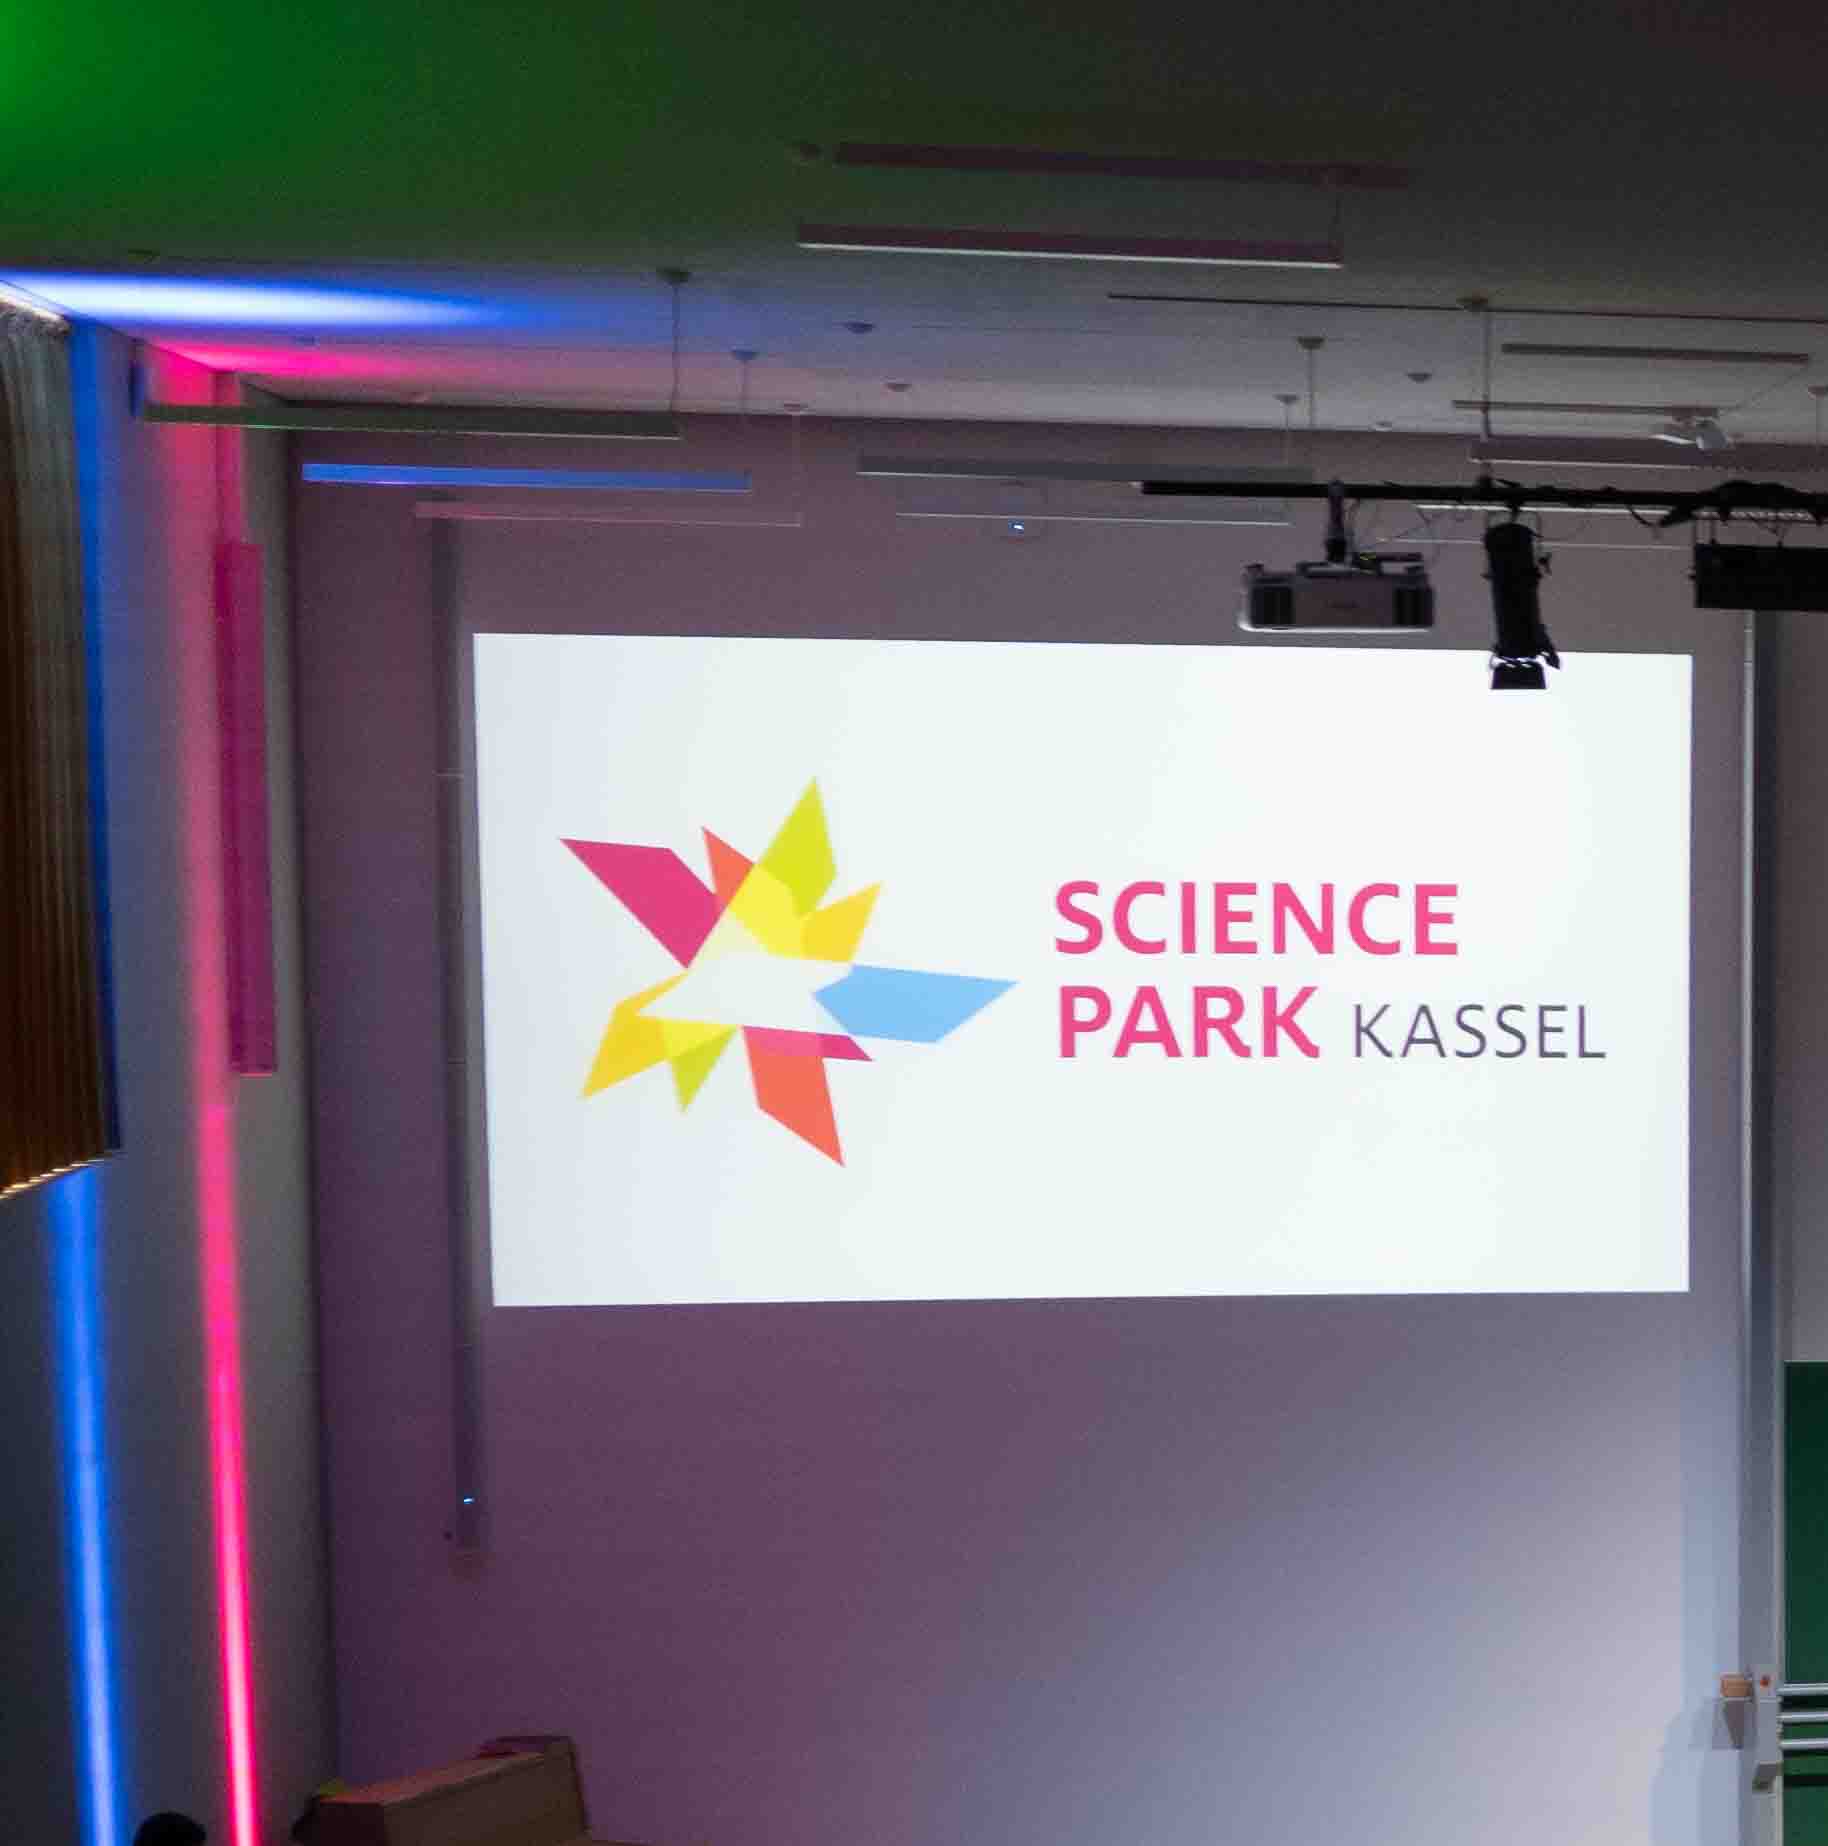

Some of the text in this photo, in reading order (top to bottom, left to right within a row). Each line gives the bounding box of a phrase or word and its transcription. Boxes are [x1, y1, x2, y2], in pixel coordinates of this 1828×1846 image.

[1055, 881, 1458, 955] SCIENCE
[1059, 986, 1606, 1058] PARK KASSEL
